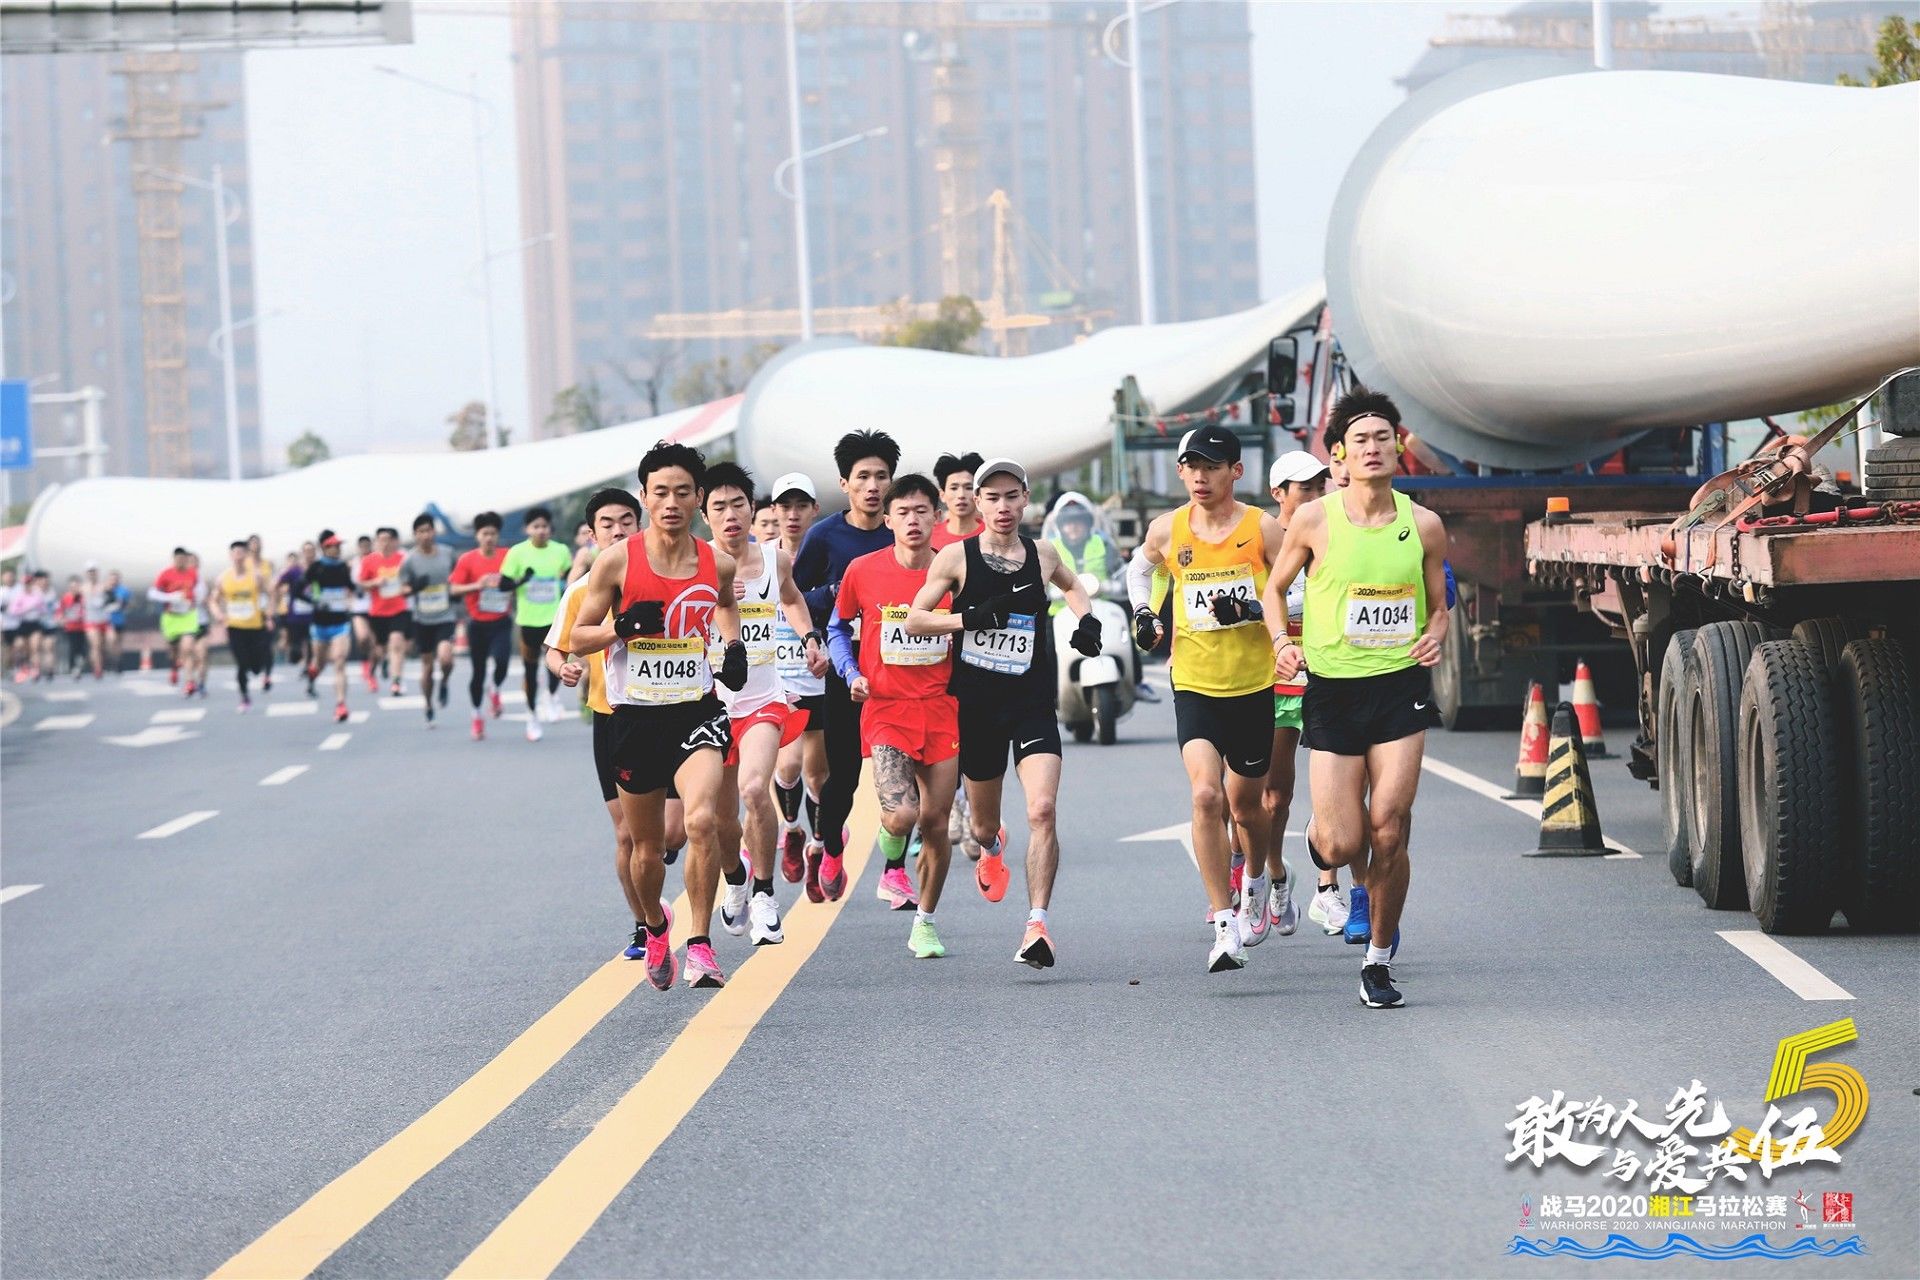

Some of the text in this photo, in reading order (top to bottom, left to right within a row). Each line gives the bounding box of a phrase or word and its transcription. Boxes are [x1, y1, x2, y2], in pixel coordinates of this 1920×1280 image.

[1356, 605, 1409, 625] A1034
[974, 630, 1027, 653] C1713
[777, 645, 804, 660] C14
[637, 660, 696, 679] A1048
